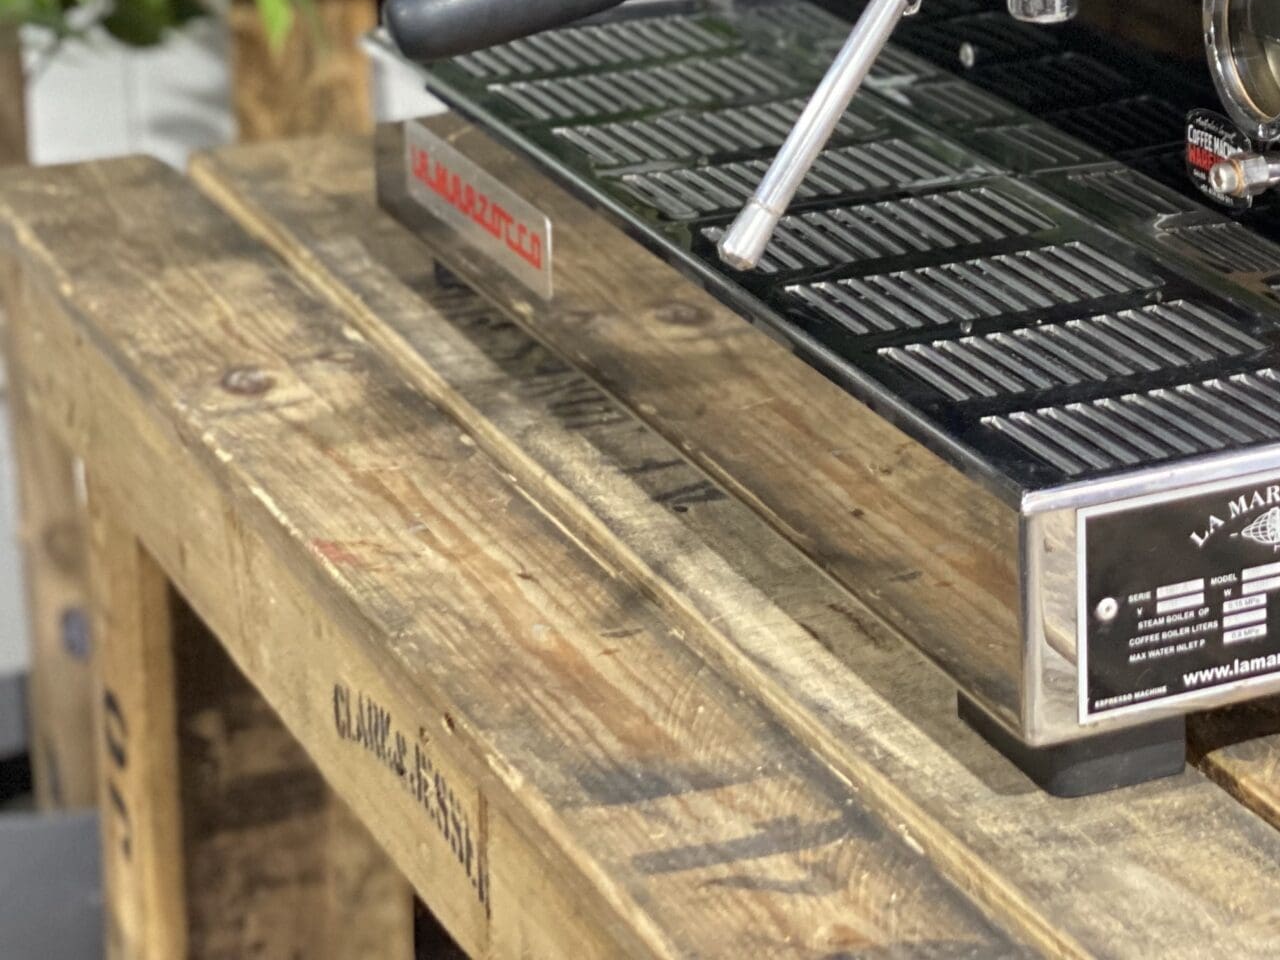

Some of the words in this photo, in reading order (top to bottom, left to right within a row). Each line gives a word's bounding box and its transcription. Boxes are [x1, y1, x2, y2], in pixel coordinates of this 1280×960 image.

[1190, 514, 1224, 547] LA
[1211, 574, 1238, 586] MODEL
[1128, 591, 1151, 603] SERIE
[1223, 588, 1232, 597] W
[1138, 615, 1165, 629] STEAM
[1166, 610, 1195, 624] BOILER
[1129, 632, 1160, 647] COFFEE
[1162, 626, 1190, 640] BOILER
[1192, 620, 1218, 633] LITERS
[1129, 651, 1146, 663] MAX
[1148, 645, 1175, 658] WATER
[1177, 640, 1198, 653] INLET
[1134, 686, 1167, 700] MACHINE
